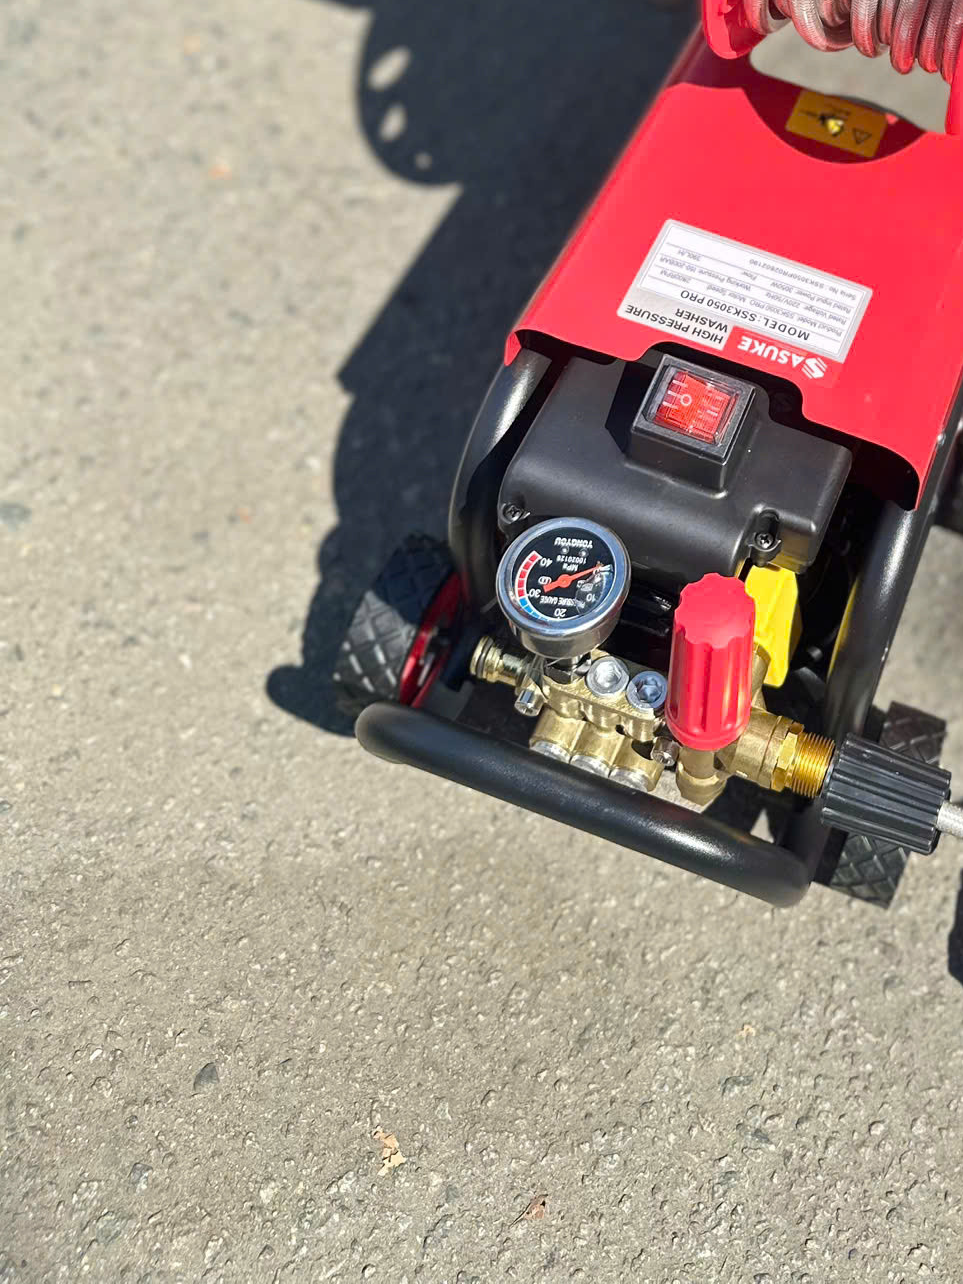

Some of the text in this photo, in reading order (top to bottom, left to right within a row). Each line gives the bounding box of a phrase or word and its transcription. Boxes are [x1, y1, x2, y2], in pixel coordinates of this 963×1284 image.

[725, 276, 752, 292] Working
[678, 288, 705, 304] PRO
[748, 298, 765, 309] PRO
[623, 303, 723, 343] HIGH PRESSURE
[673, 307, 730, 333] WASHER
[554, 536, 593, 548] YONGYOU
[540, 557, 553, 568] 40
[529, 588, 541, 597] 30
[586, 593, 596, 602] 10
[554, 608, 567, 617] 20
